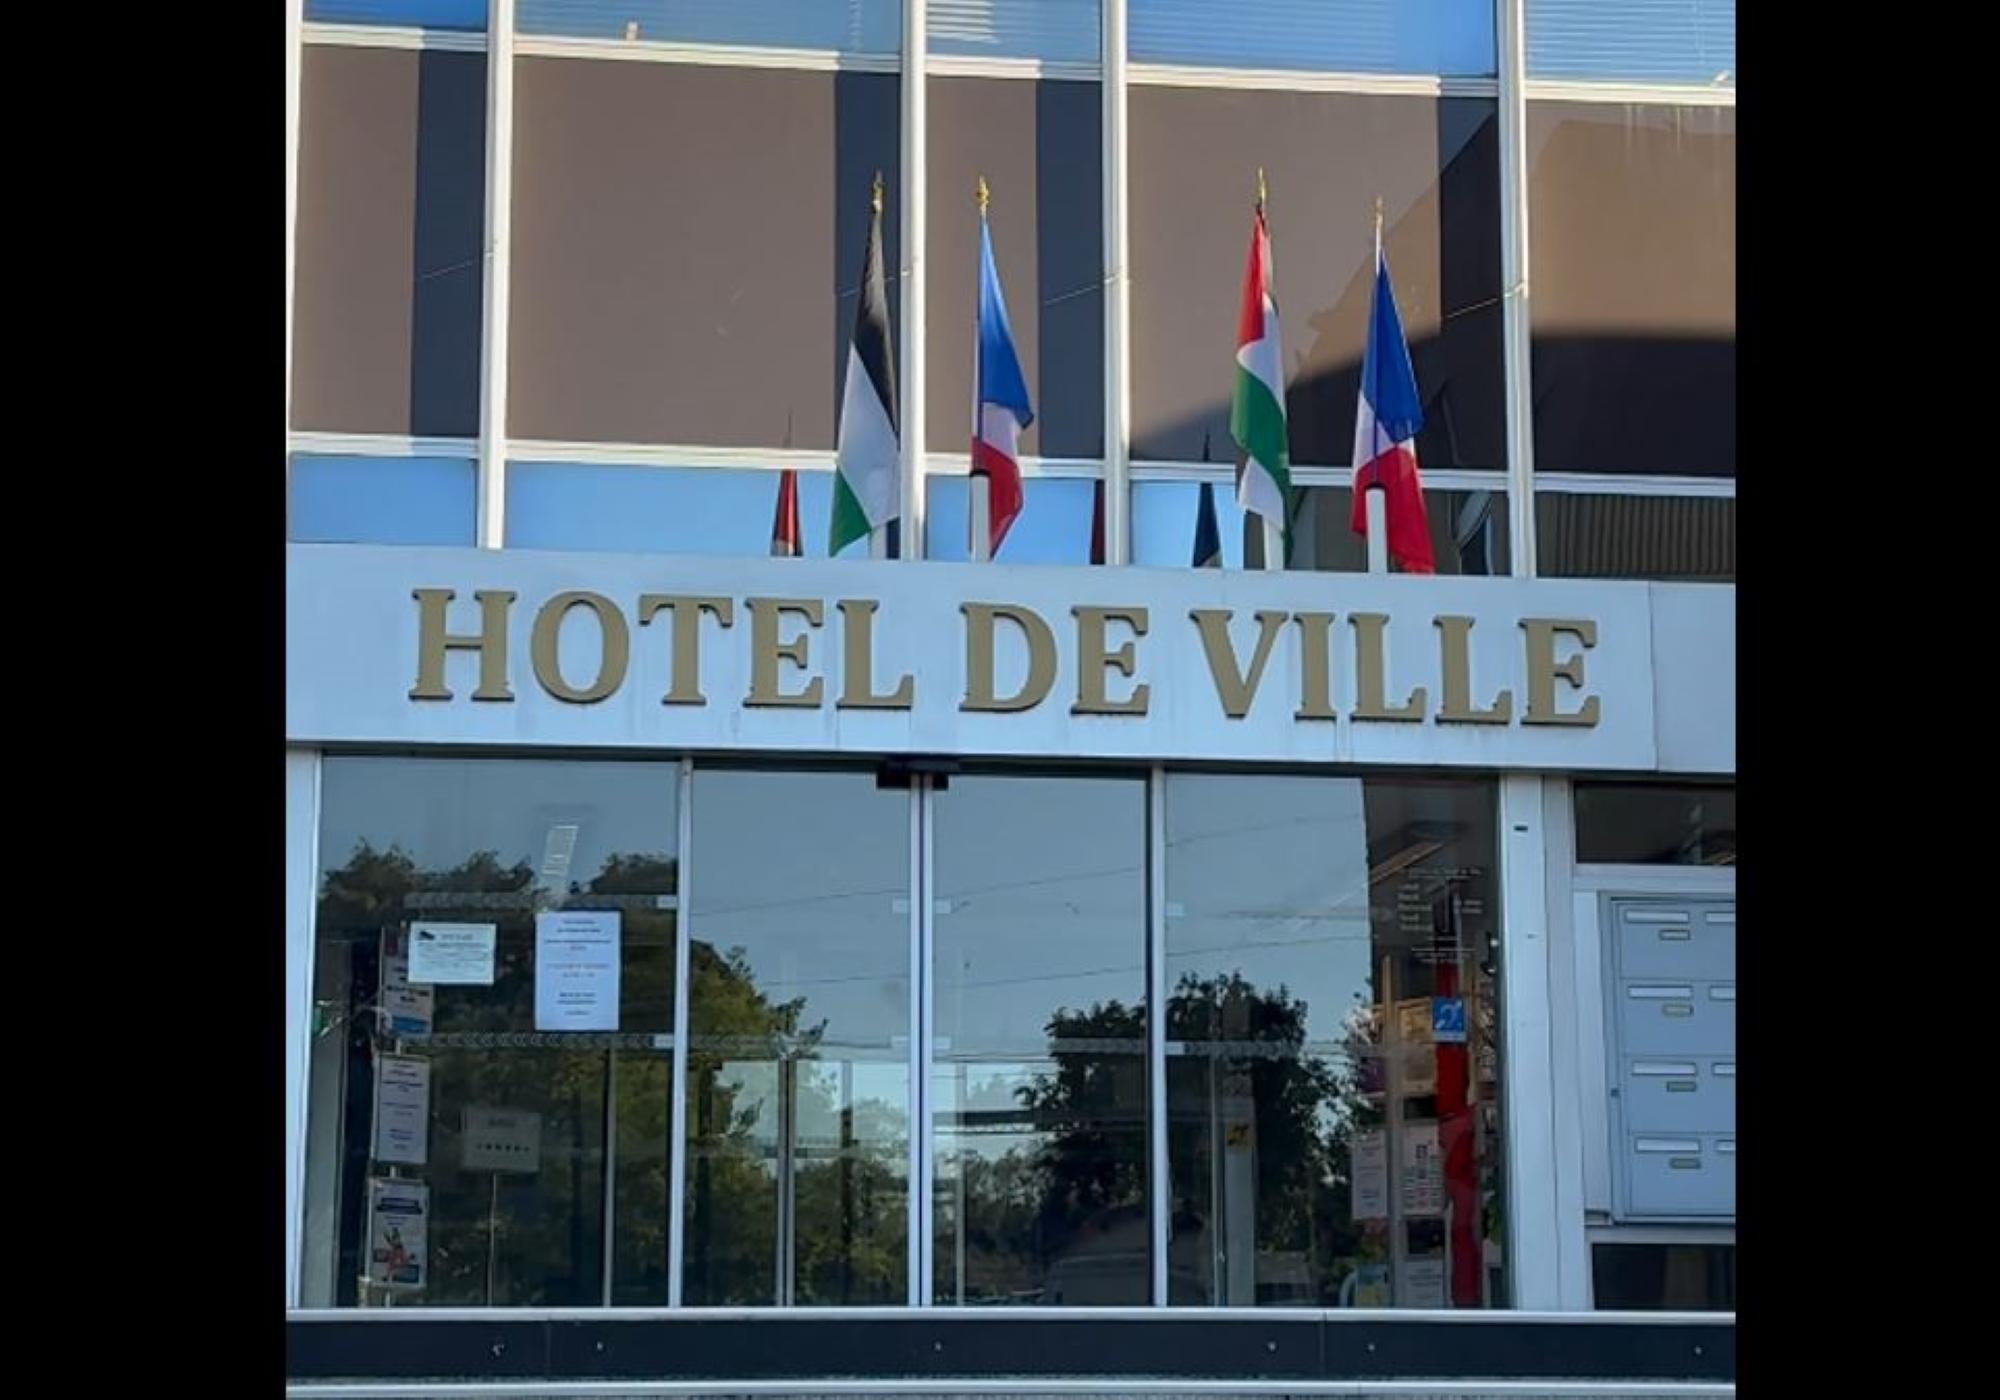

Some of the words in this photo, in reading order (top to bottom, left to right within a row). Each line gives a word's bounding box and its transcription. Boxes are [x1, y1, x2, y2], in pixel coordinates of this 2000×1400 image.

[408, 588, 915, 709] HOTEL
[959, 603, 1150, 715] DE
[1190, 609, 1600, 727] VILLE
